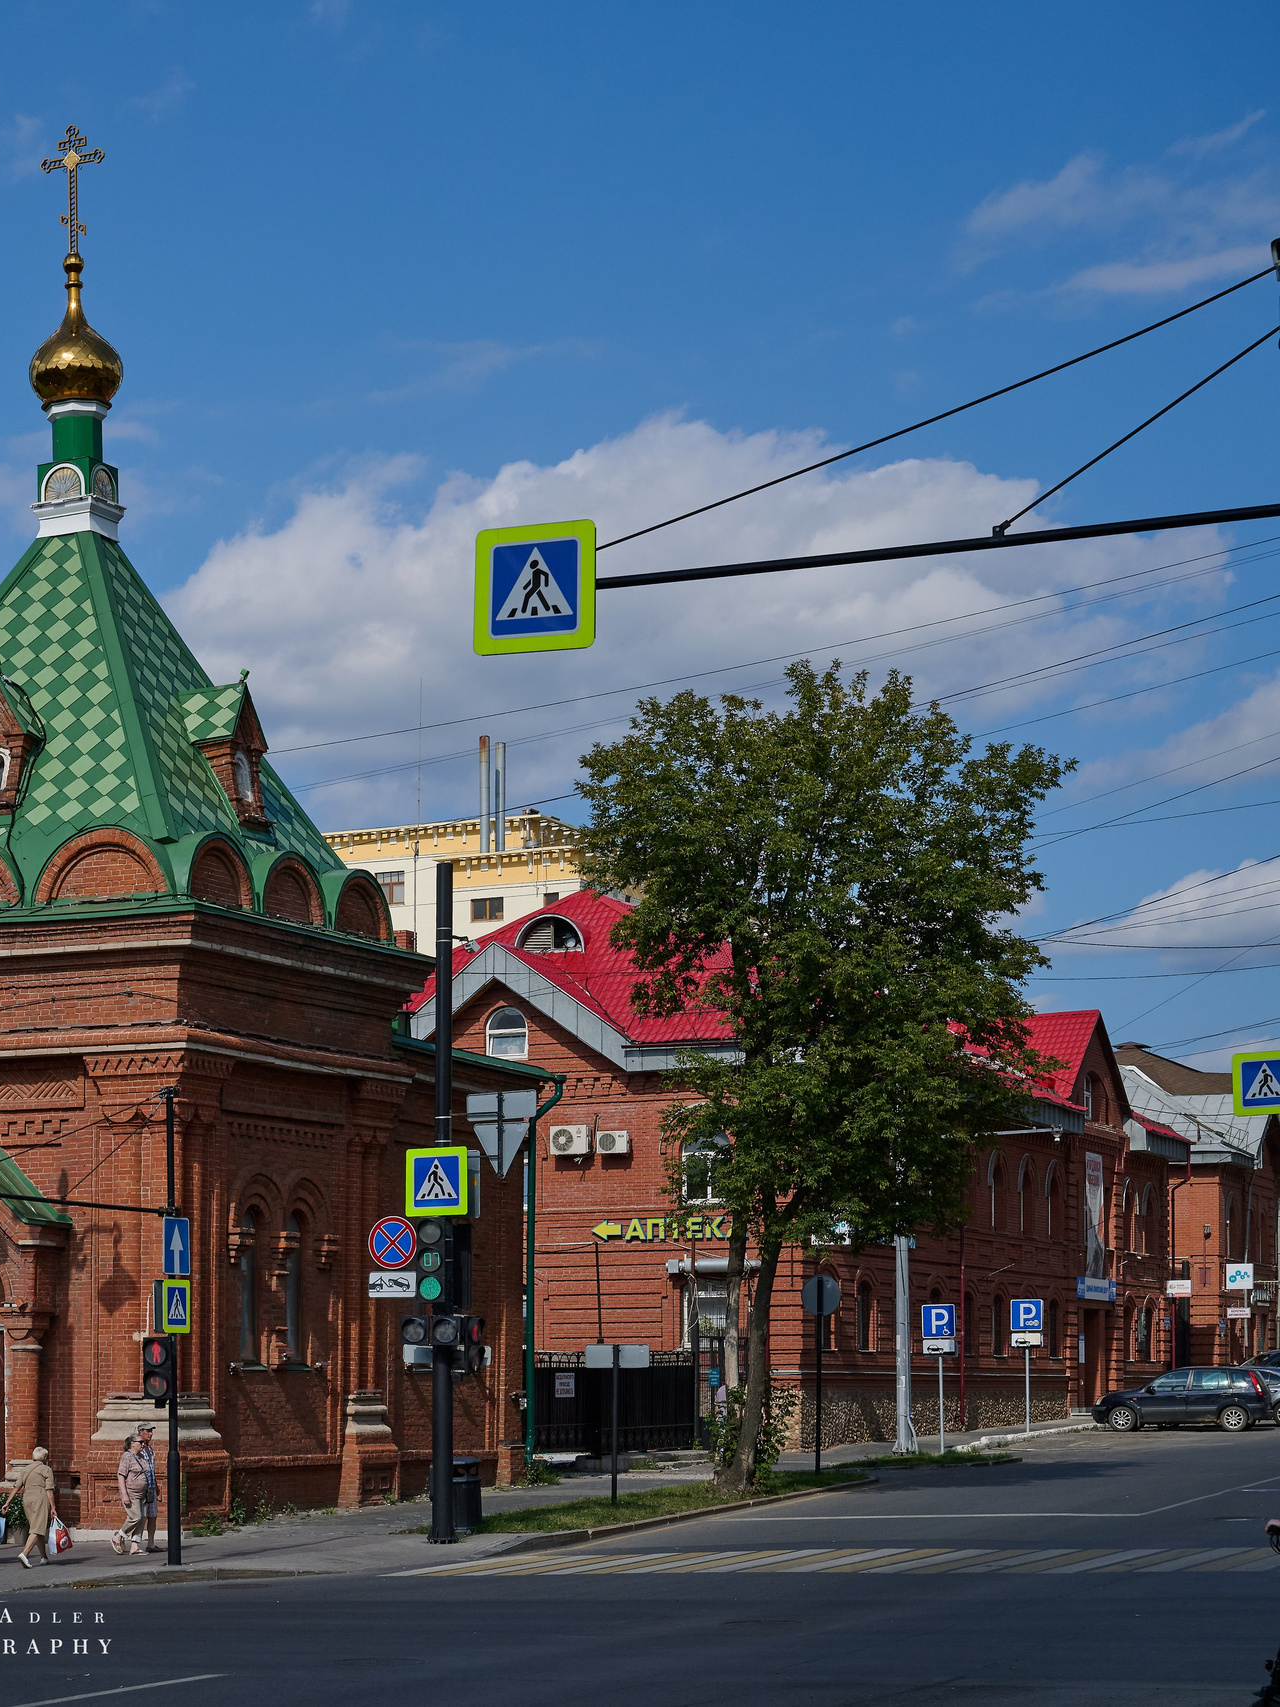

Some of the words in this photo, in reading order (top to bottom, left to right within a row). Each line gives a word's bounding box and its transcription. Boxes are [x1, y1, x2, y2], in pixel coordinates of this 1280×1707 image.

[423, 1252, 440, 1267] 07
[931, 1308, 949, 1334] P
[1019, 1303, 1037, 1327] P
